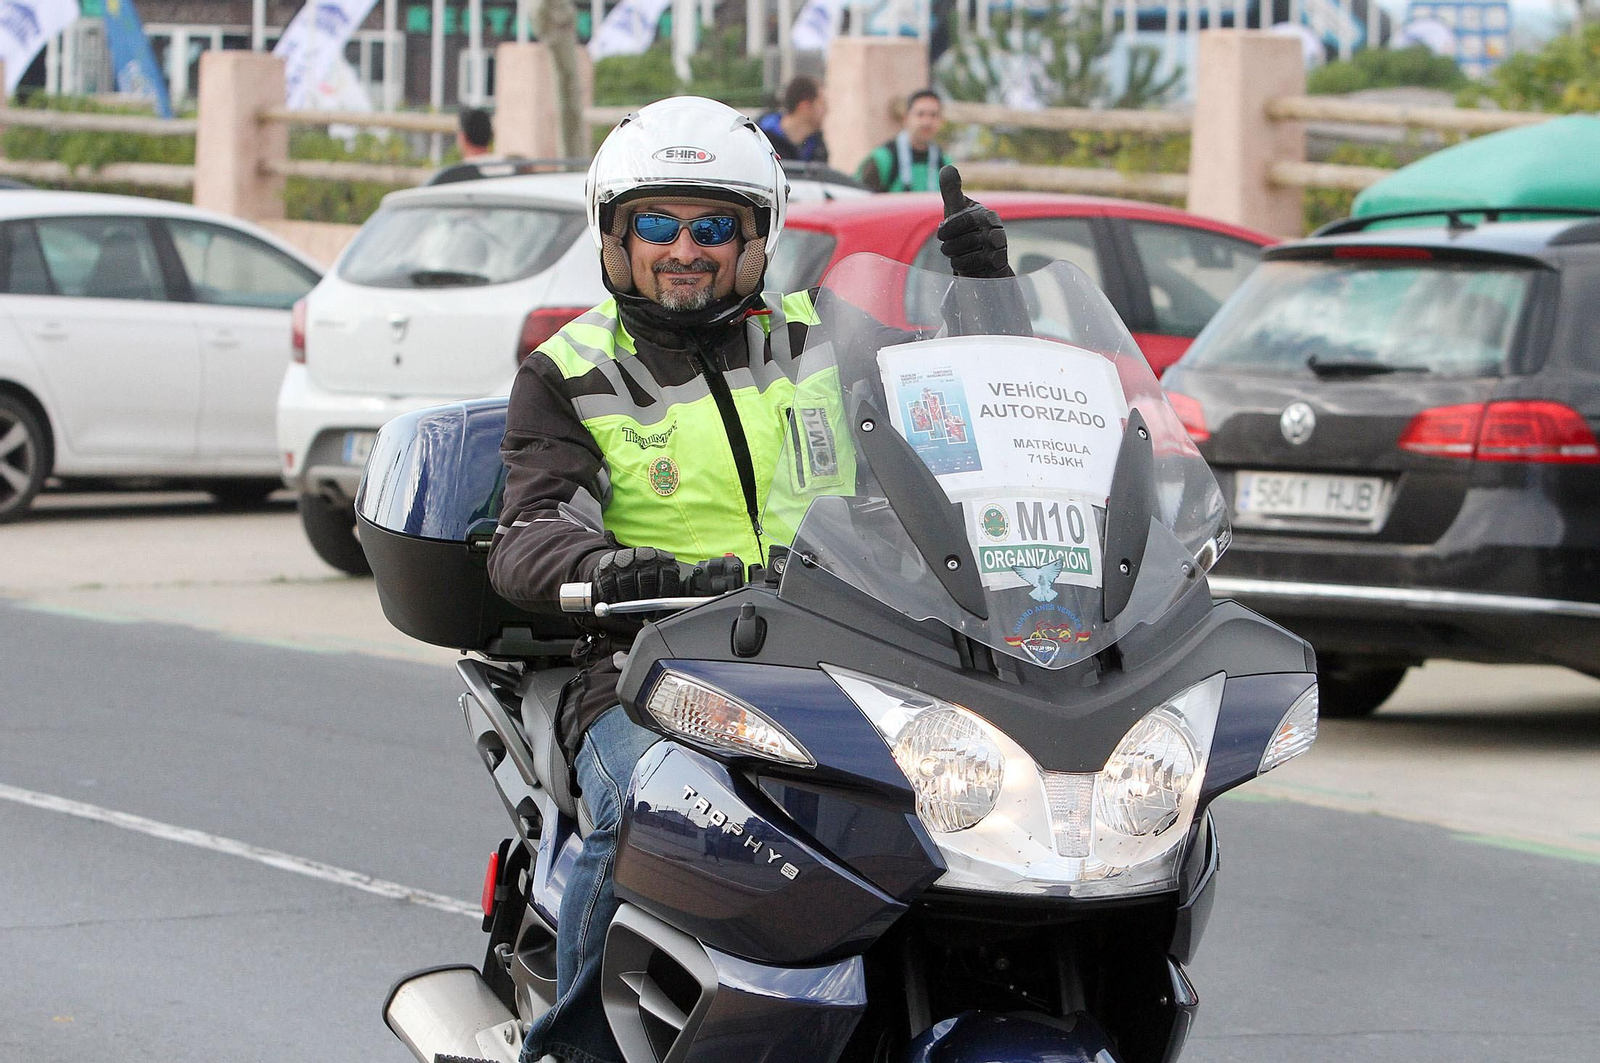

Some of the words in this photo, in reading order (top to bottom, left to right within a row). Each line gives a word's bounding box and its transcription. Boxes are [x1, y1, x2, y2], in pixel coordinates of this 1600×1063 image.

[665, 149, 707, 160] SHIRO
[988, 381, 1088, 405] VEHÍCULO
[979, 404, 1106, 429] AUTORIZADO
[1013, 438, 1091, 456] MATRÍCULA
[1028, 453, 1084, 468] 7155JKH
[1016, 501, 1085, 545] M10
[984, 547, 1088, 571] ORGANIZACIÓN
[682, 784, 783, 864] TROPHY
